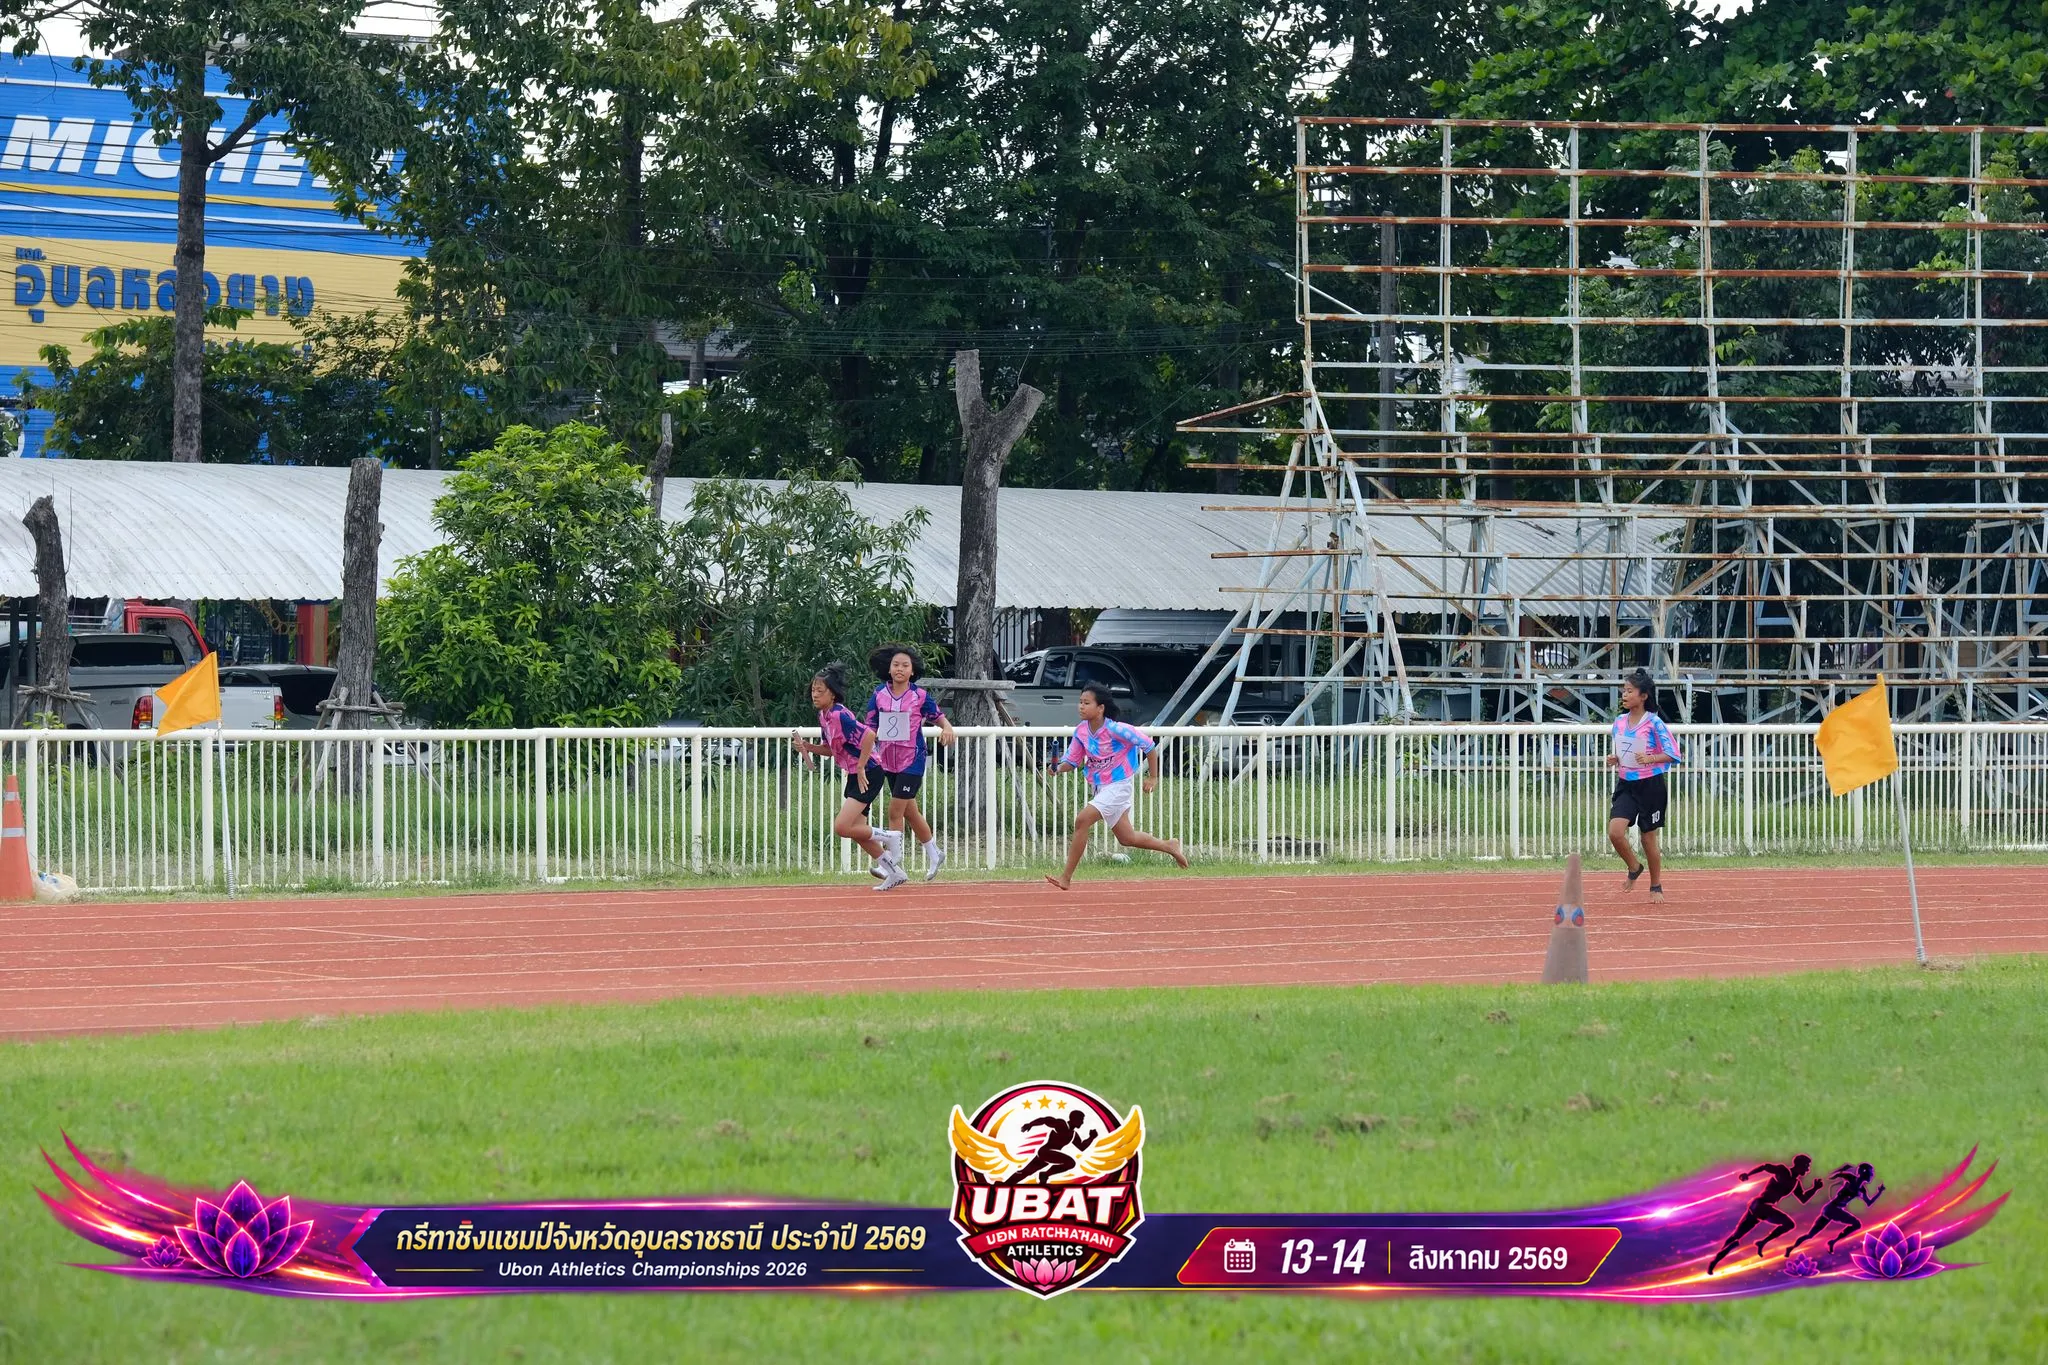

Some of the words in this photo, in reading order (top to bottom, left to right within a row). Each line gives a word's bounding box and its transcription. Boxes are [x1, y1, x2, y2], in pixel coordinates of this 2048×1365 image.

[886, 715, 899, 738] 8
[1621, 741, 1633, 760] 7
[1651, 810, 1660, 824] 10
